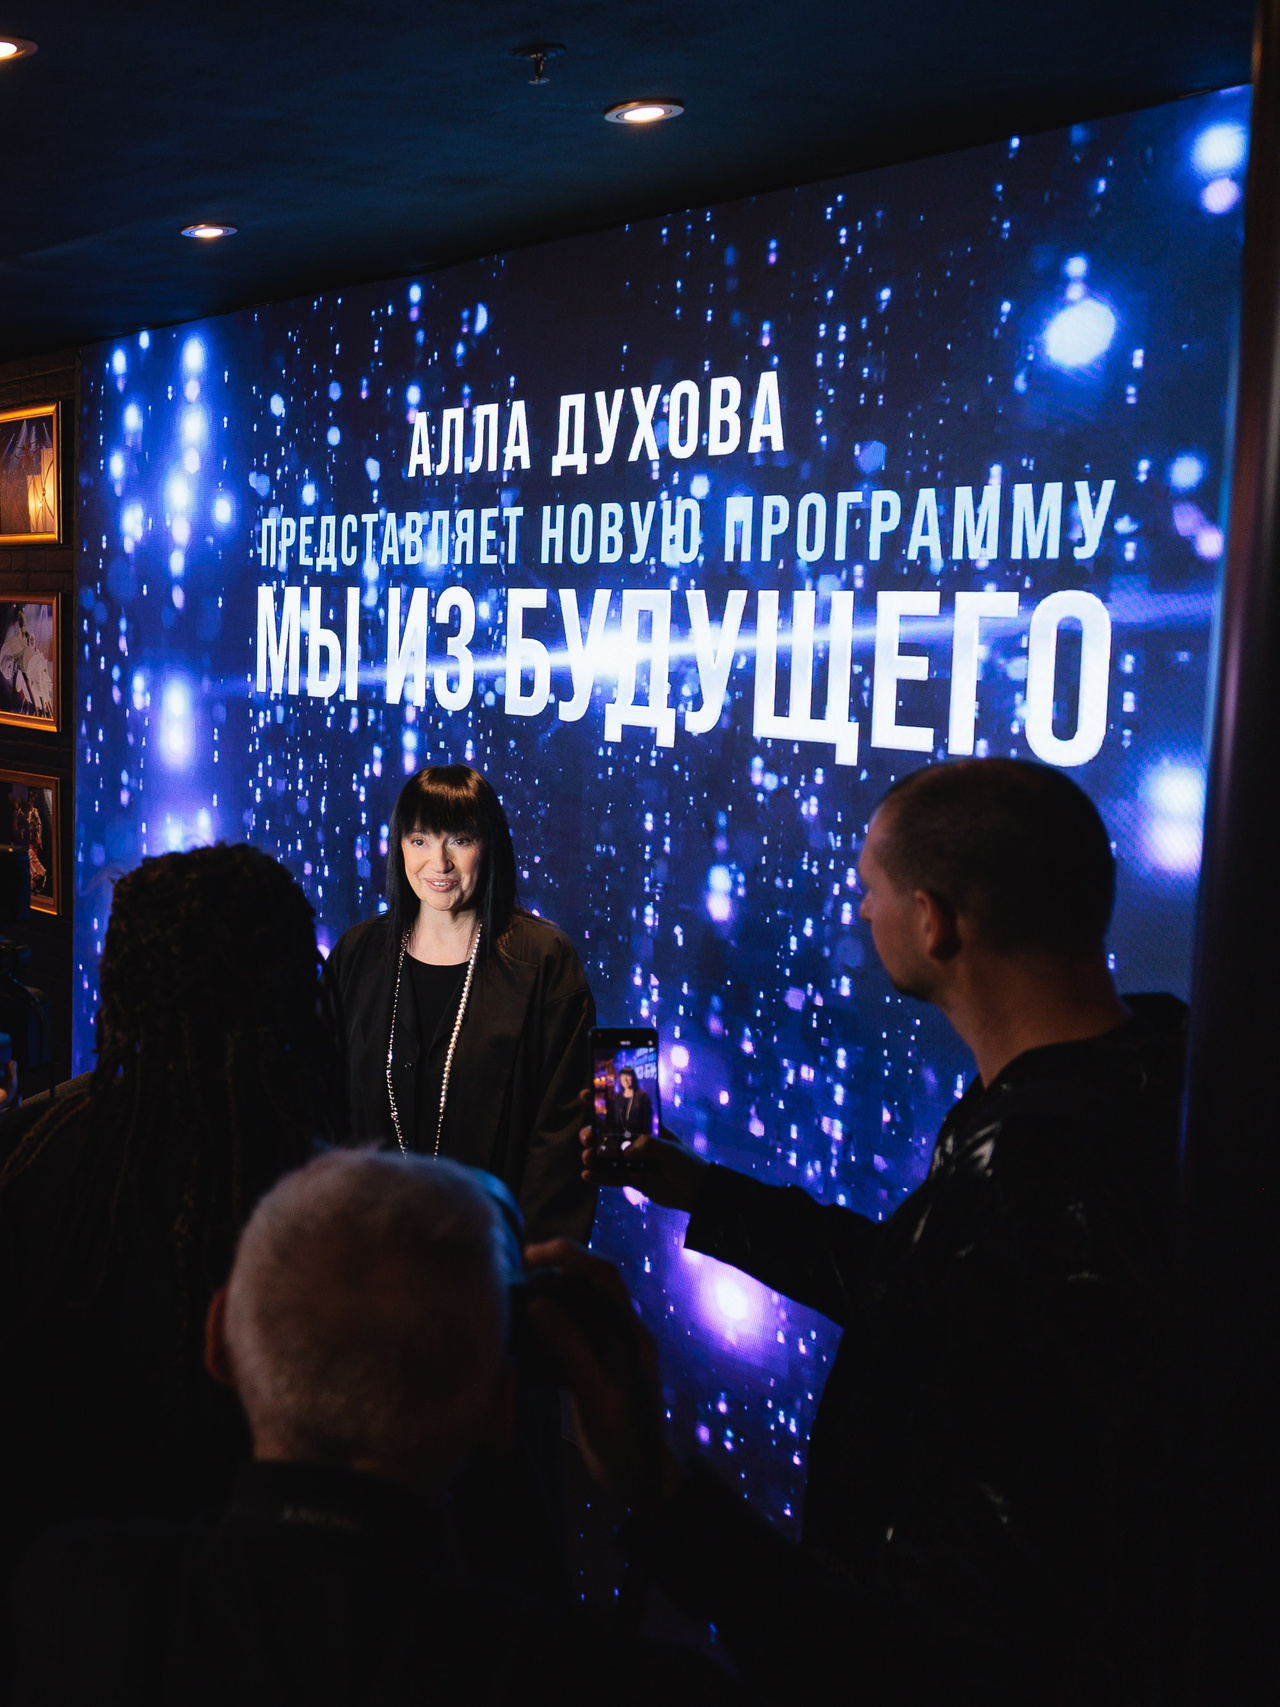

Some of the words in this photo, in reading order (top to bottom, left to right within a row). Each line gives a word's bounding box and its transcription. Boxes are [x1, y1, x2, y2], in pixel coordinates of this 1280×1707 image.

[407, 400, 529, 478] АЛЛА
[552, 370, 785, 477] ДУХОВА
[260, 506, 524, 571] ПРЕДСТАВЛЯЕТ
[540, 499, 702, 564] НОВУЮ
[724, 478, 1116, 563] ПРОГРАММУ
[255, 586, 359, 701] МЫ
[384, 586, 476, 710] ИЗ
[504, 588, 1113, 767] БУДУЩЕГО
